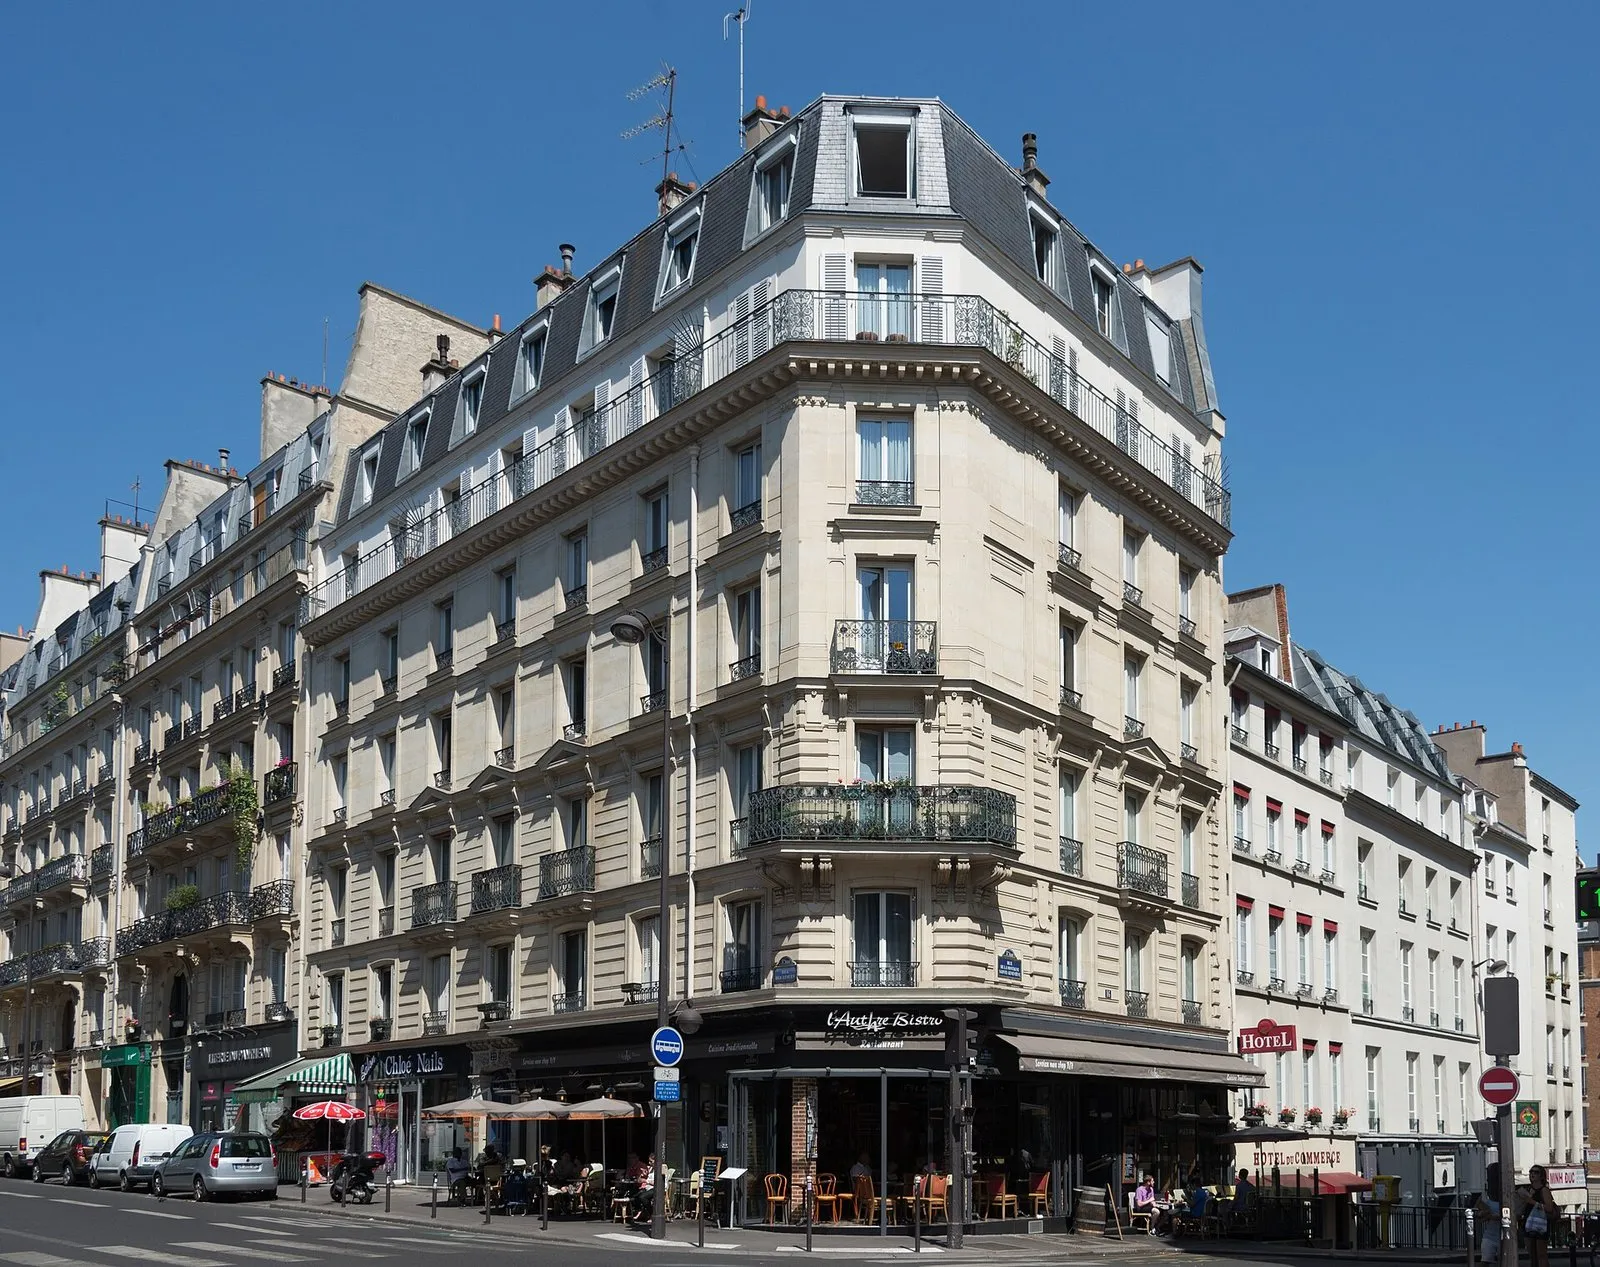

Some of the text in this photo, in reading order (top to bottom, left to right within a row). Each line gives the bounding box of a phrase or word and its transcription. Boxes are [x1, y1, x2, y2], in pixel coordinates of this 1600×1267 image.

[892, 1011, 943, 1027] Bistro
[859, 1039, 904, 1049] Restaurant
[385, 1051, 443, 1075] Chloé Nails
[1253, 1151, 1341, 1166] HOTEL DU COMMERCE
